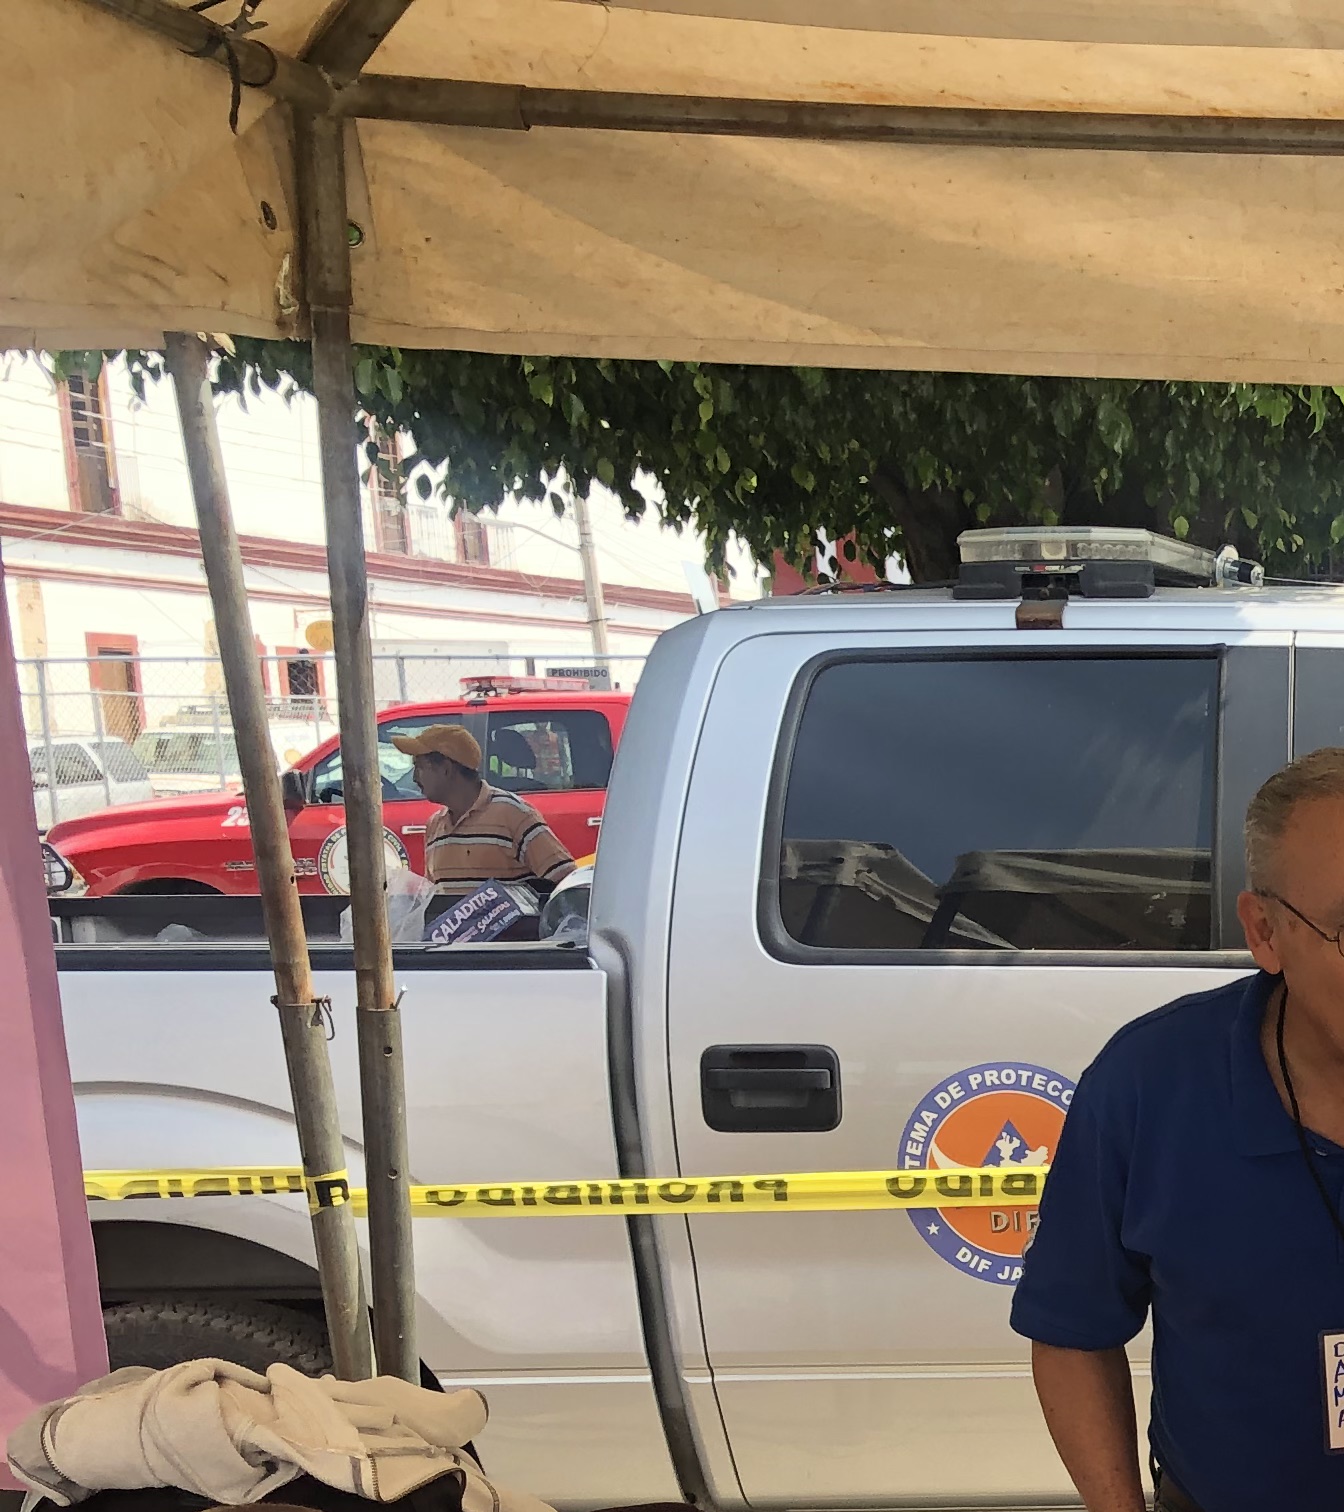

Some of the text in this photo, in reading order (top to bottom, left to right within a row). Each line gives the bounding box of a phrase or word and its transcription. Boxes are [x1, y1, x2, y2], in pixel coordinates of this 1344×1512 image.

[551, 668, 608, 678] PROHIBIDO
[431, 887, 498, 943] SALADITAS
[934, 1082, 965, 1110] DE
[956, 1246, 993, 1273] DIF
